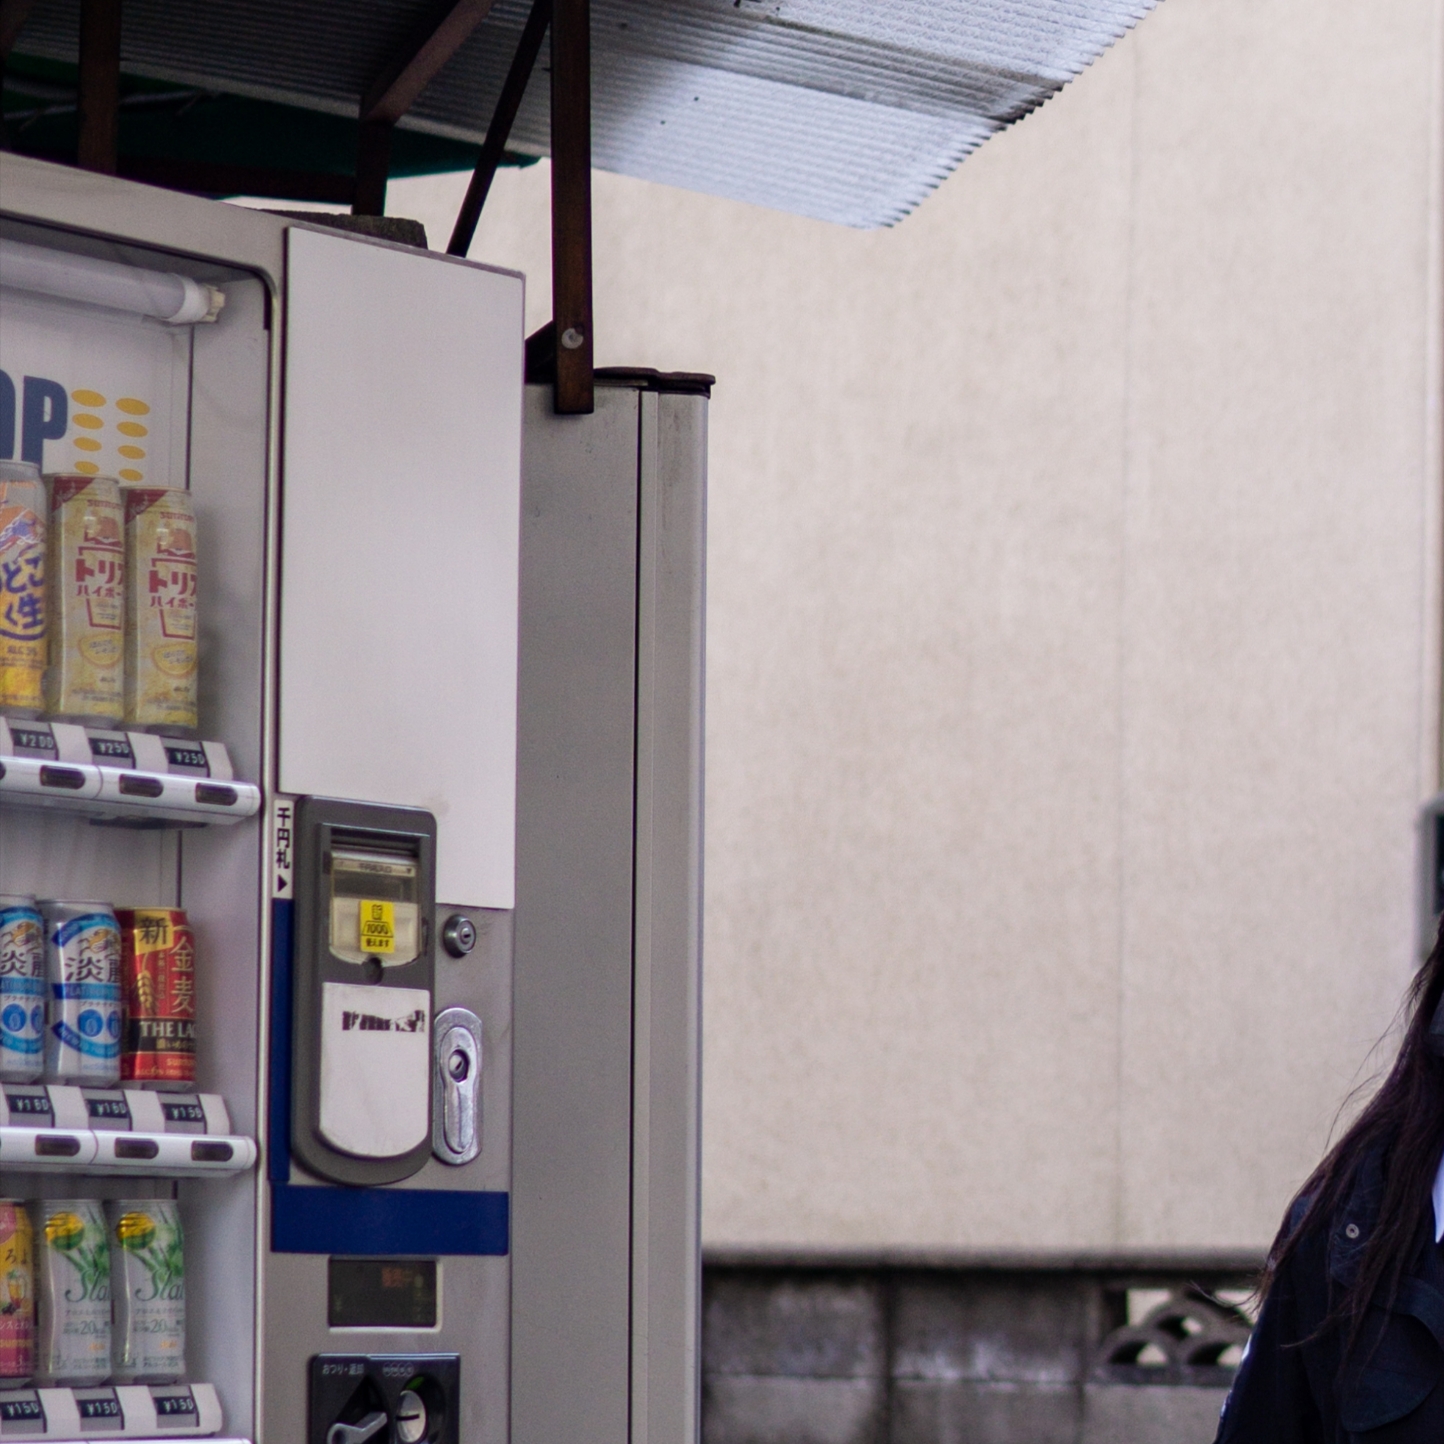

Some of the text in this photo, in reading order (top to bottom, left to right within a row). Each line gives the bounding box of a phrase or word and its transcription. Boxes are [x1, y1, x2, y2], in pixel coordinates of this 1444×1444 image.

[276, 806, 291, 869] 千円札
[140, 916, 169, 946] 新
[171, 936, 194, 1014] 金麦
[139, 1021, 174, 1038] THE
[65, 1269, 110, 1302] Sla
